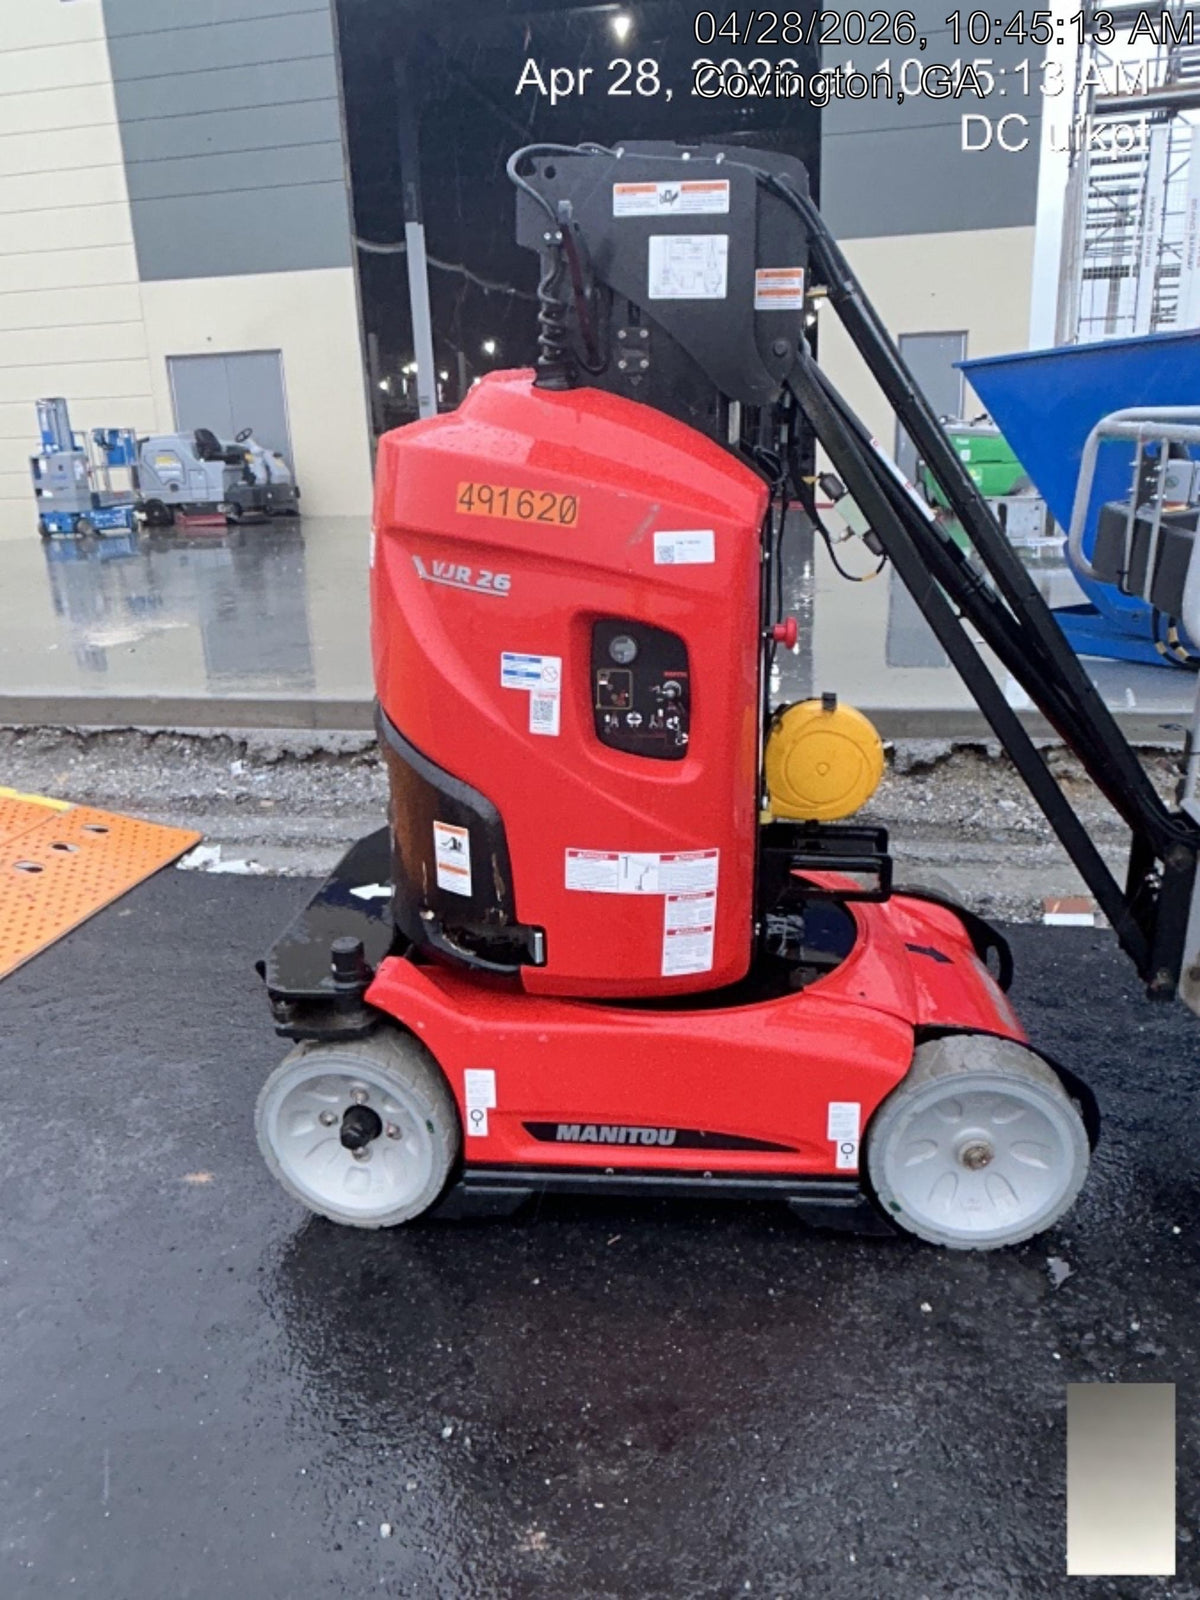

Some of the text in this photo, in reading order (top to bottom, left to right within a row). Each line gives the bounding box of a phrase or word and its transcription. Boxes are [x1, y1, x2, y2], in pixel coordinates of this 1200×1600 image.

[458, 482, 577, 525] 491620
[431, 559, 511, 592] VJR 26
[556, 1124, 677, 1146] MANITOU
